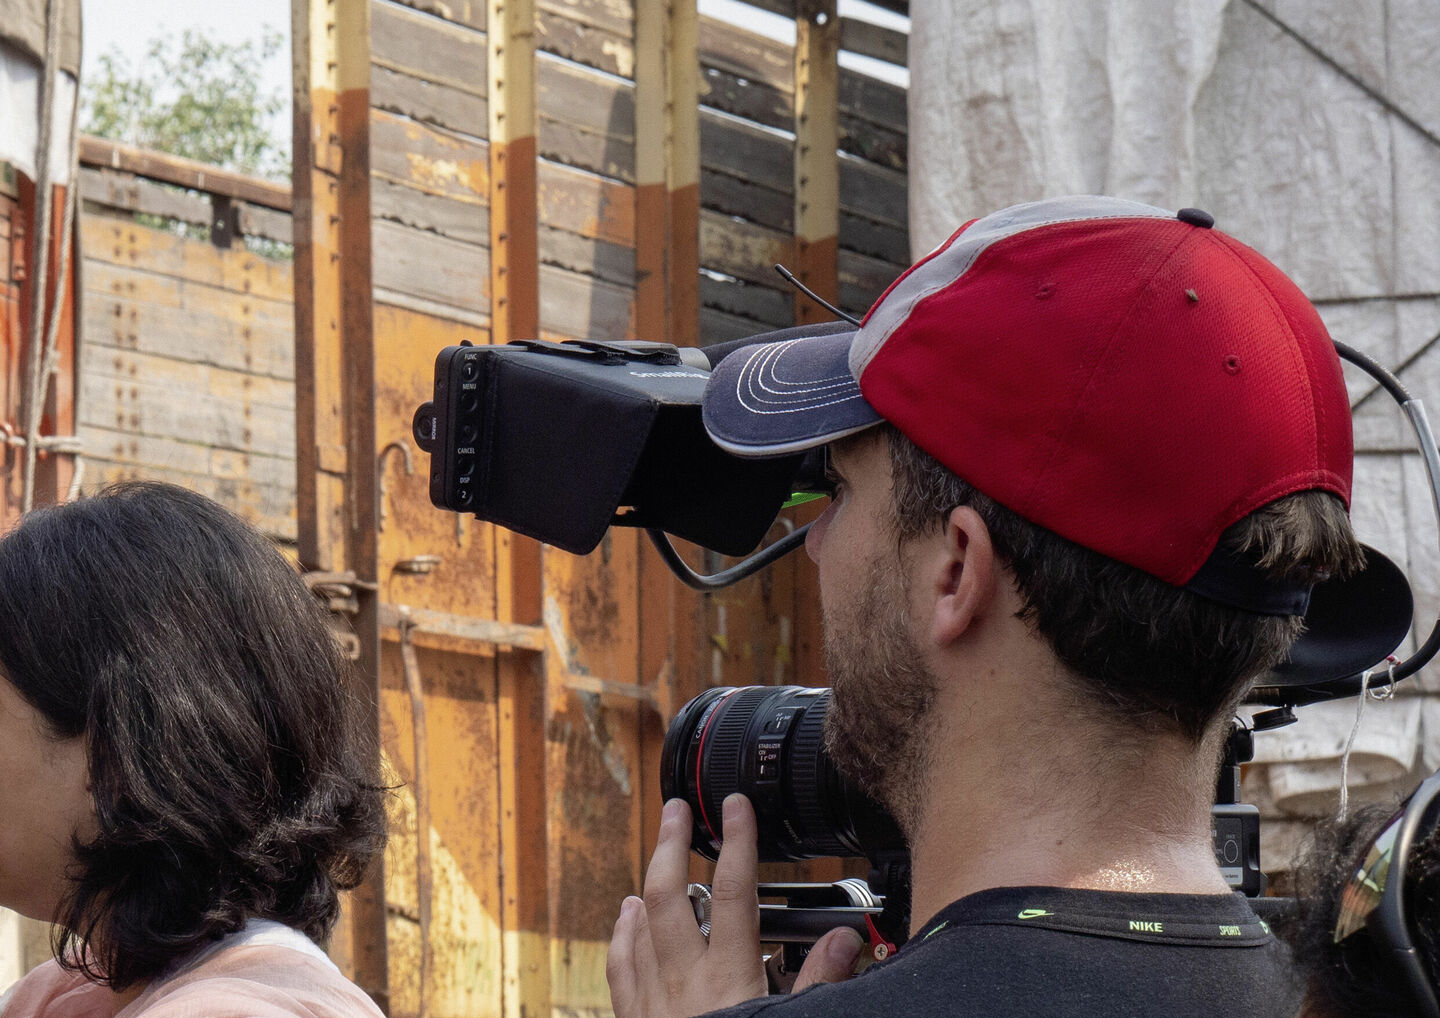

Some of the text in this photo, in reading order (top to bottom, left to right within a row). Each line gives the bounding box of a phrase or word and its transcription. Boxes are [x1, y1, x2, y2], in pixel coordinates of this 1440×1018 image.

[457, 447, 475, 455] CANCEL
[1129, 921, 1242, 936] NIKE SPORTS
